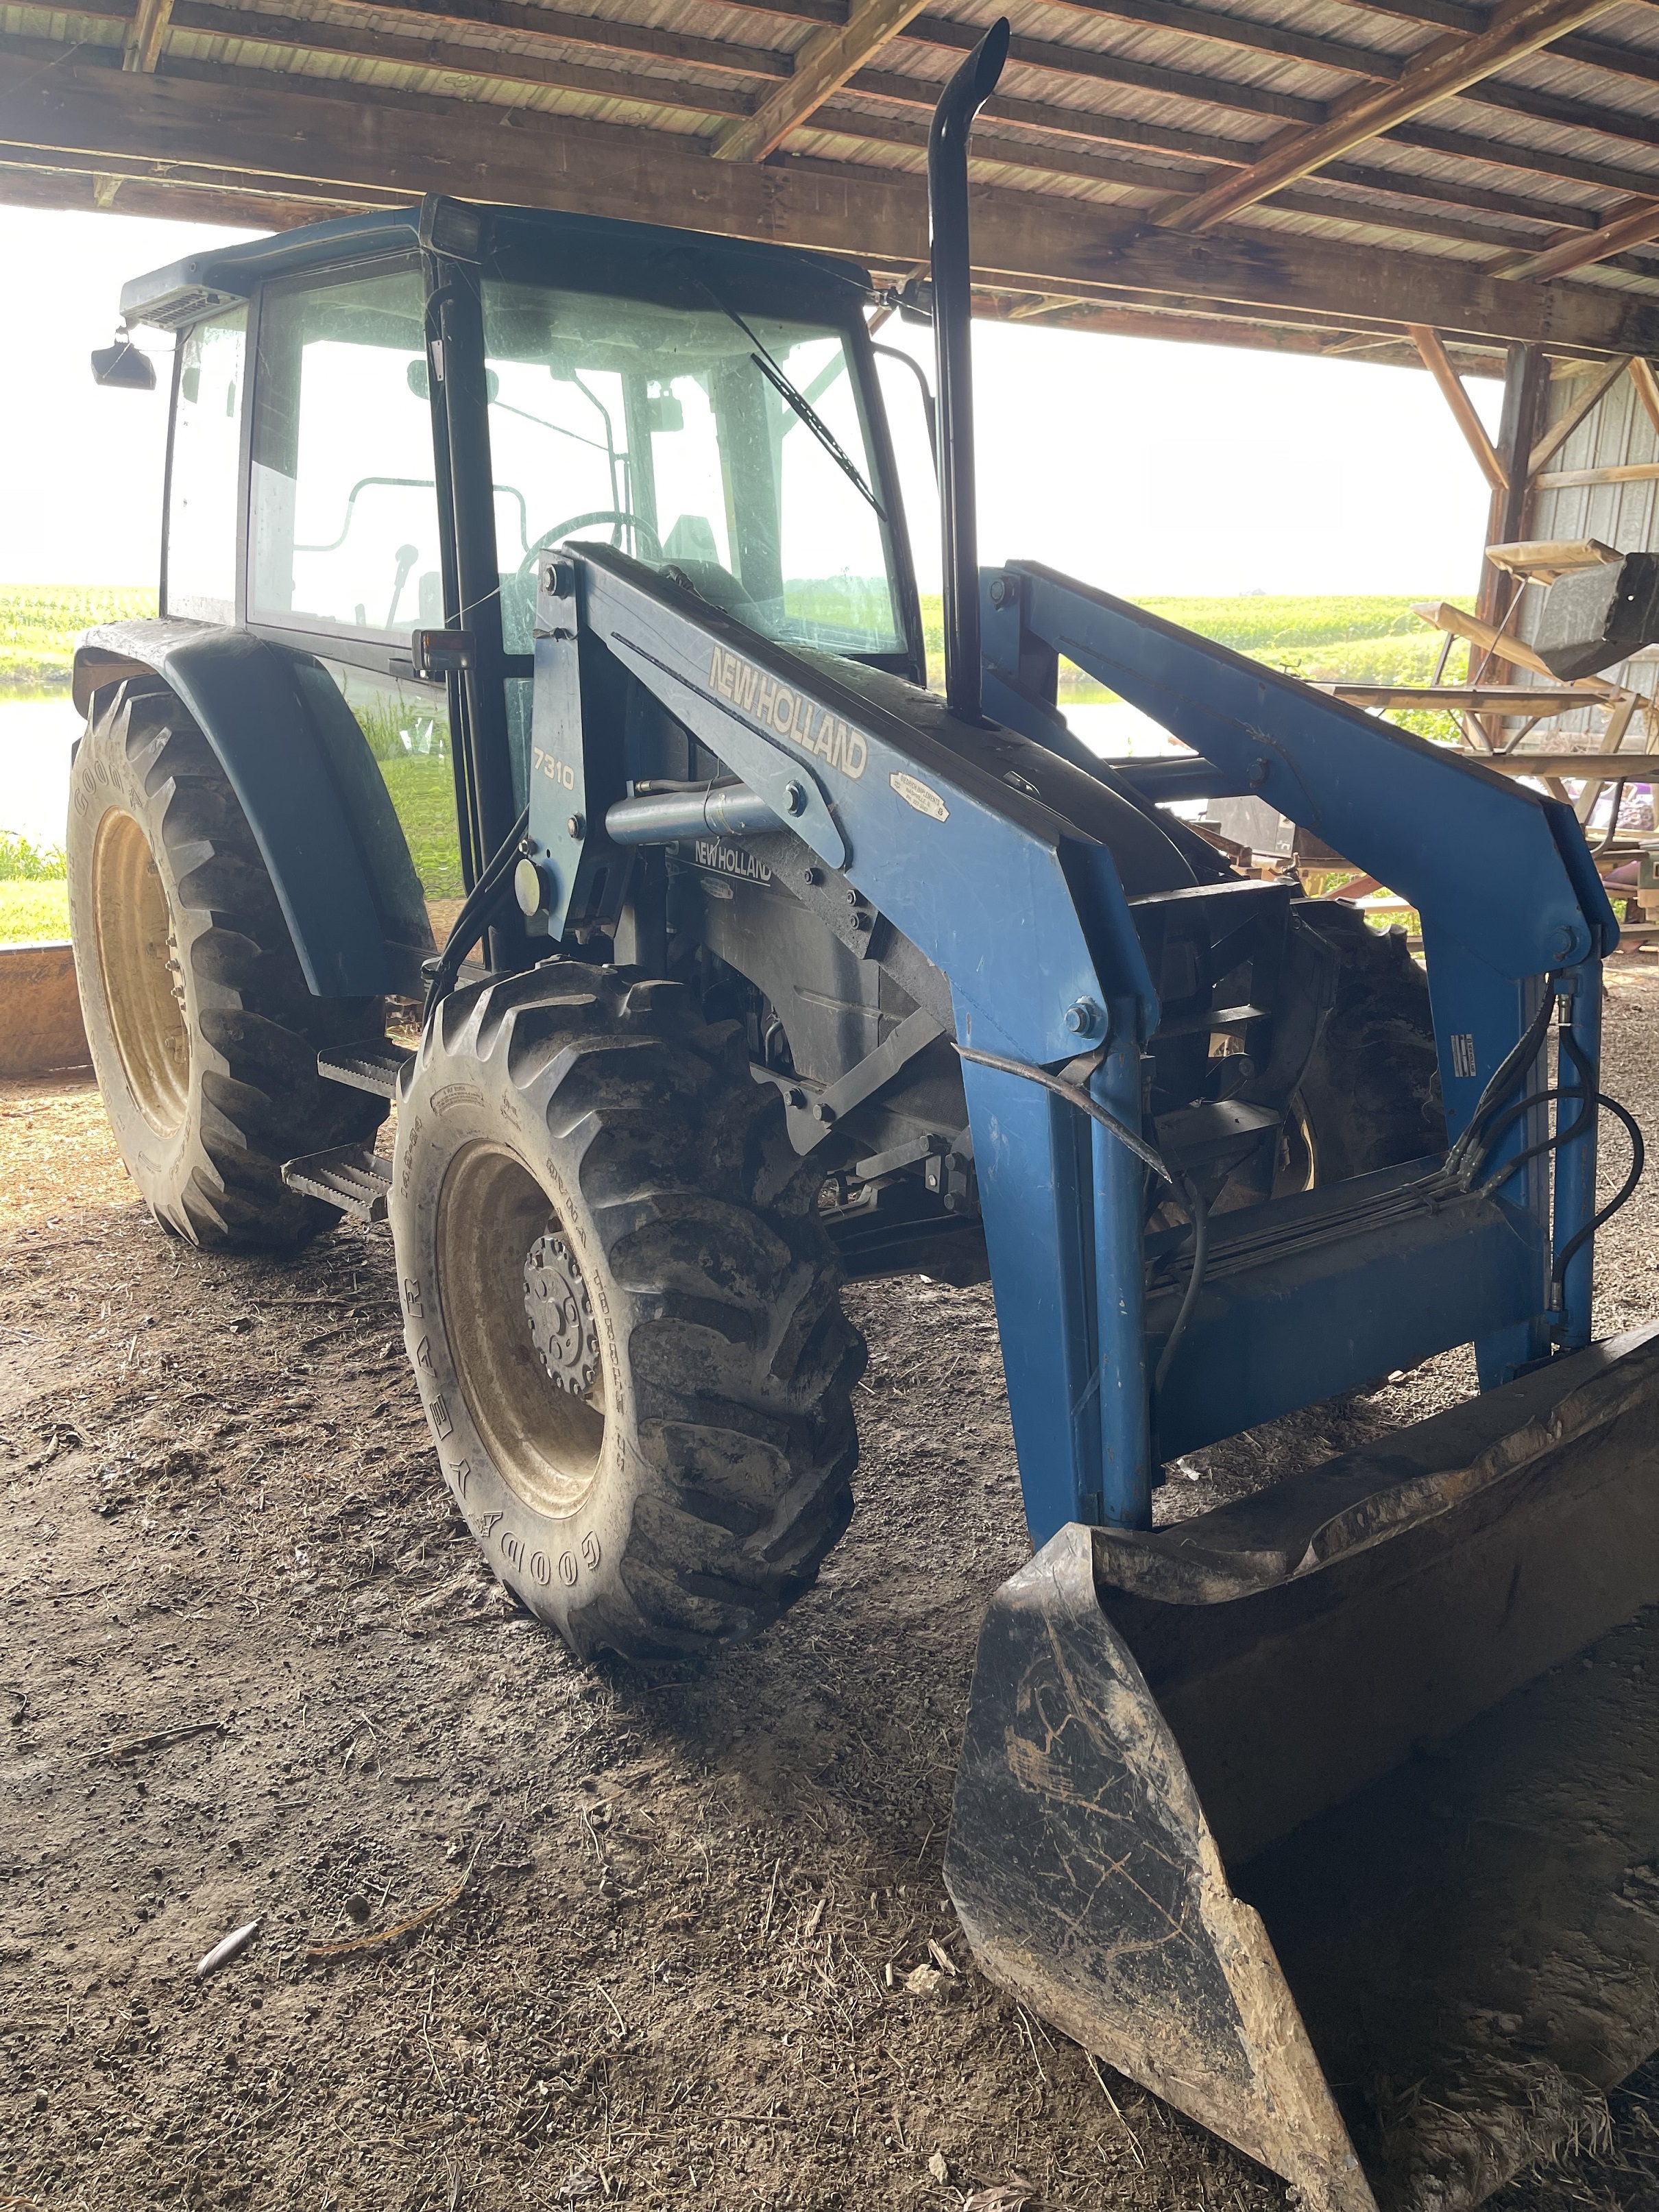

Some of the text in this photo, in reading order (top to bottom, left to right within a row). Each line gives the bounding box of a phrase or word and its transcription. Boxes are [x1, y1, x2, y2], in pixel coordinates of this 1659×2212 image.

[708, 644, 869, 781] NEW HOLLAND
[534, 745, 574, 791] 7310
[695, 841, 718, 867] NEW
[718, 847, 772, 881] HOLLAND
